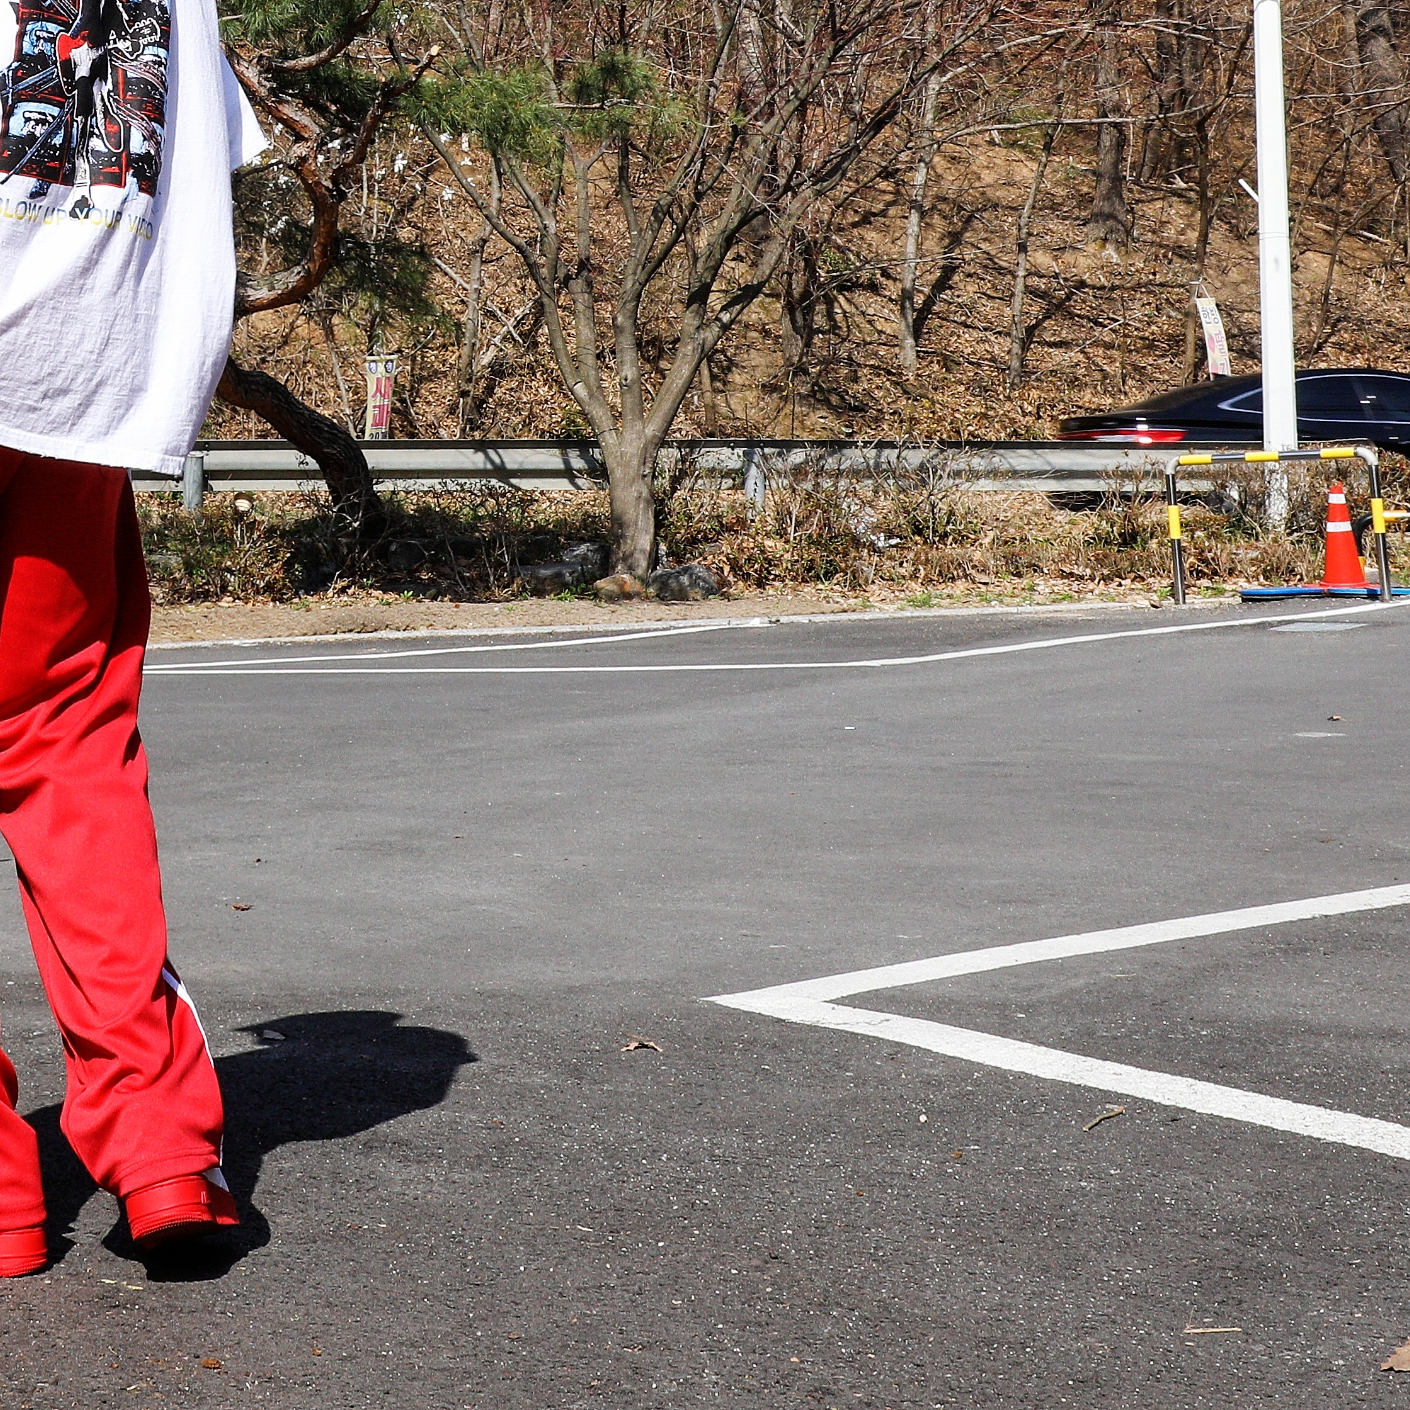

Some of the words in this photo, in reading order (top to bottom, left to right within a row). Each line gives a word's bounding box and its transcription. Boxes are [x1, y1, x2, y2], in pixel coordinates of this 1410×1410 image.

[43, 207, 67, 226] UP
[74, 207, 123, 230] YOUR
[371, 376, 393, 428] 사과
